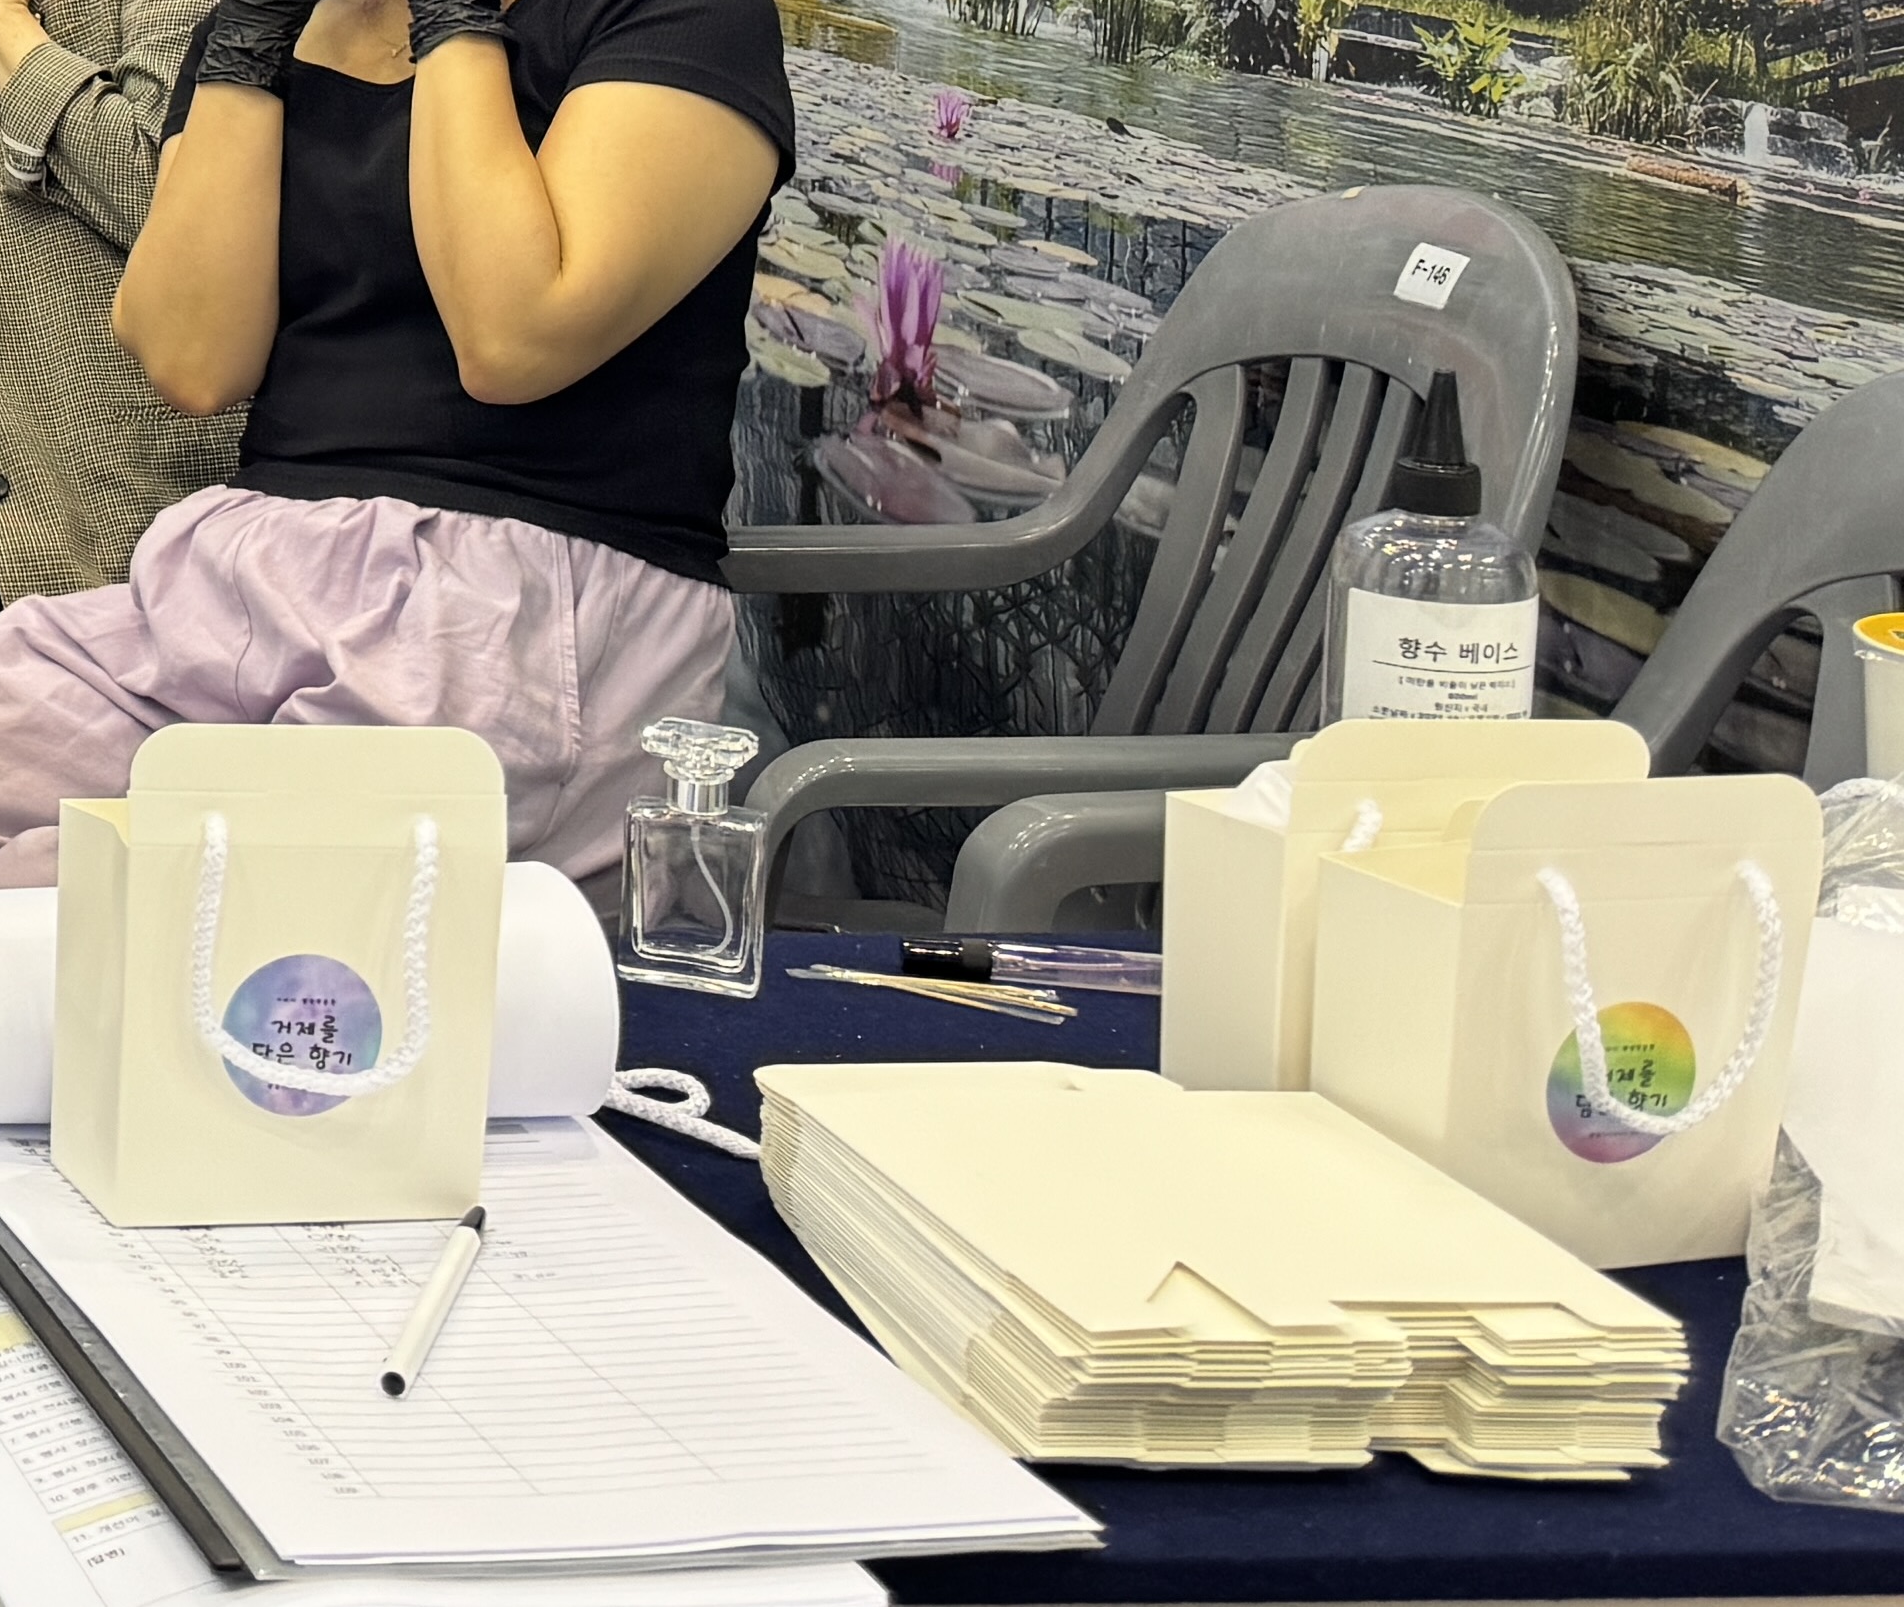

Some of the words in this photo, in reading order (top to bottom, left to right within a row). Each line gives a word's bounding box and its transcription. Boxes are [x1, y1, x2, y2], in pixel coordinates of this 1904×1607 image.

[1398, 637, 1447, 663] 향수
[1458, 642, 1519, 665] 베이스
[271, 1014, 339, 1044] 거제를
[309, 1043, 352, 1071] 향기
